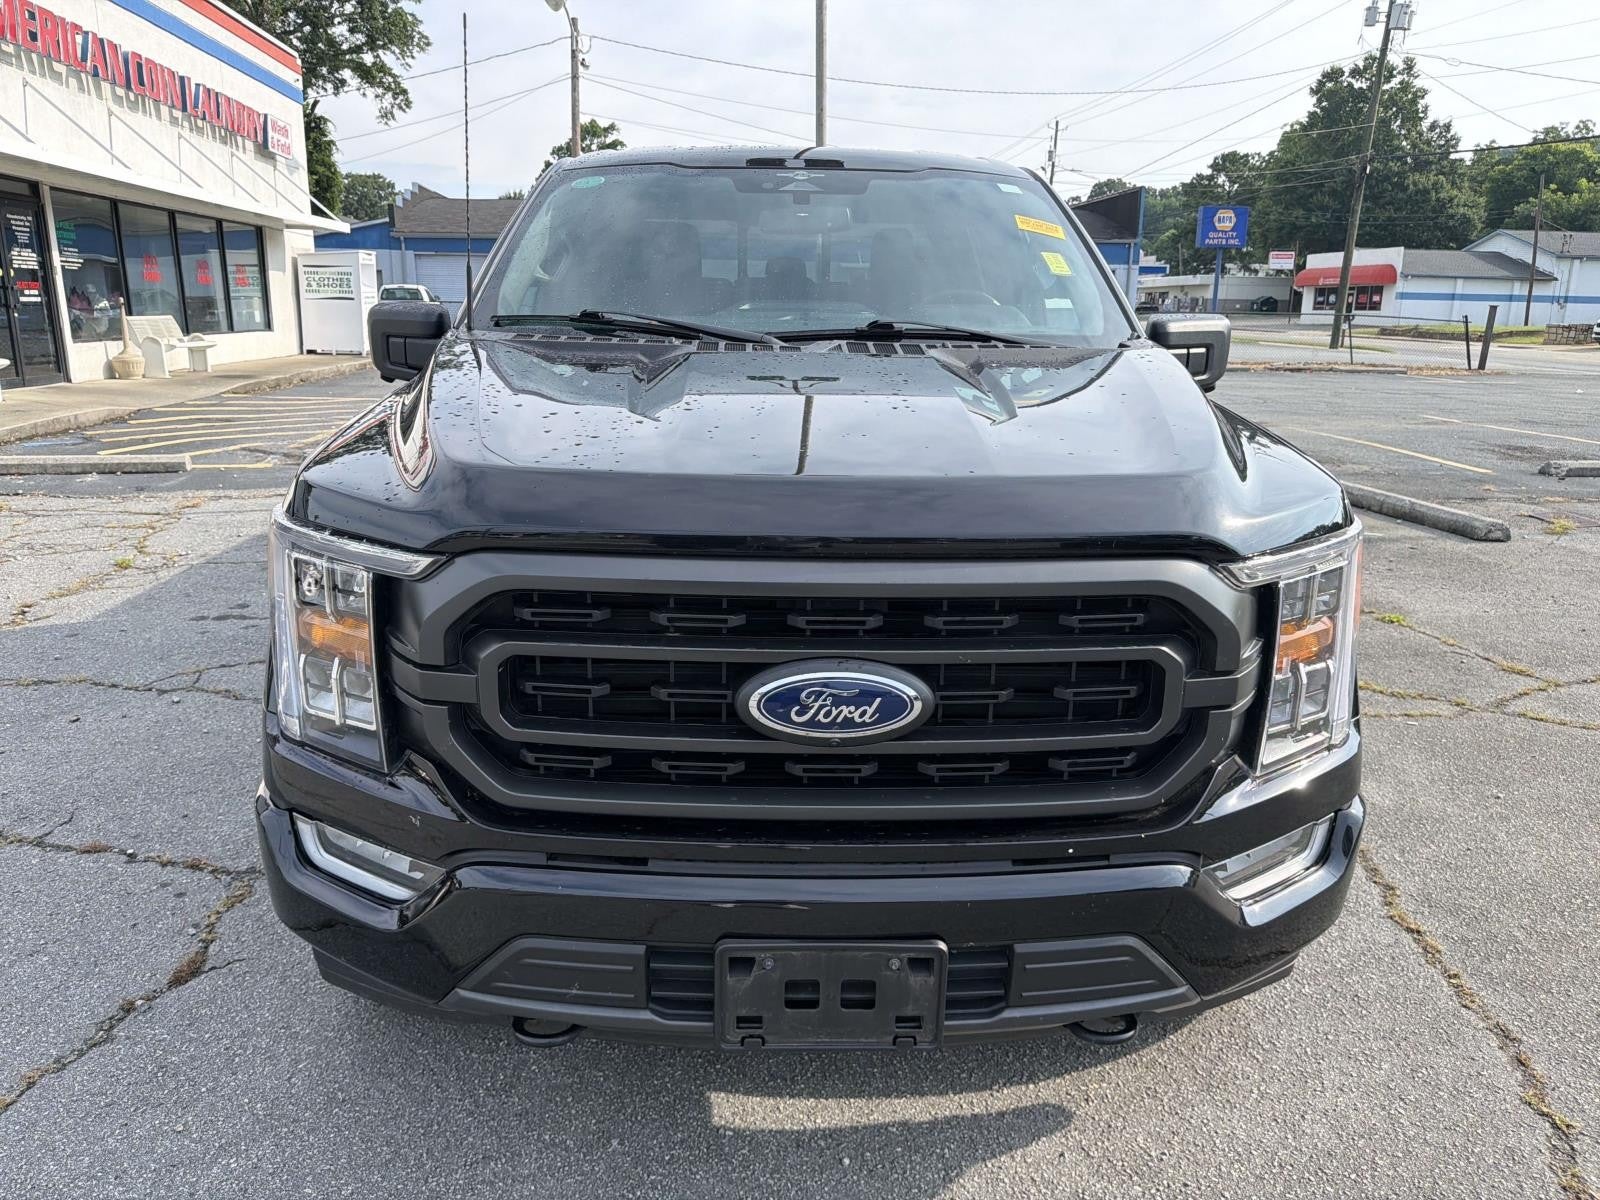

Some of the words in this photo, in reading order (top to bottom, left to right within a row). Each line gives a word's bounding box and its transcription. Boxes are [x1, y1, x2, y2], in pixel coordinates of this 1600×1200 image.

[129, 50, 183, 112] COIN
[186, 76, 265, 145] LAUNDRY
[270, 118, 289, 139] Wash
[277, 138, 291, 156] Fold
[1218, 216, 1233, 225] NAPA
[1208, 231, 1237, 239] QUALITY
[1228, 238, 1241, 246] INC.
[790, 687, 882, 723] Ford
